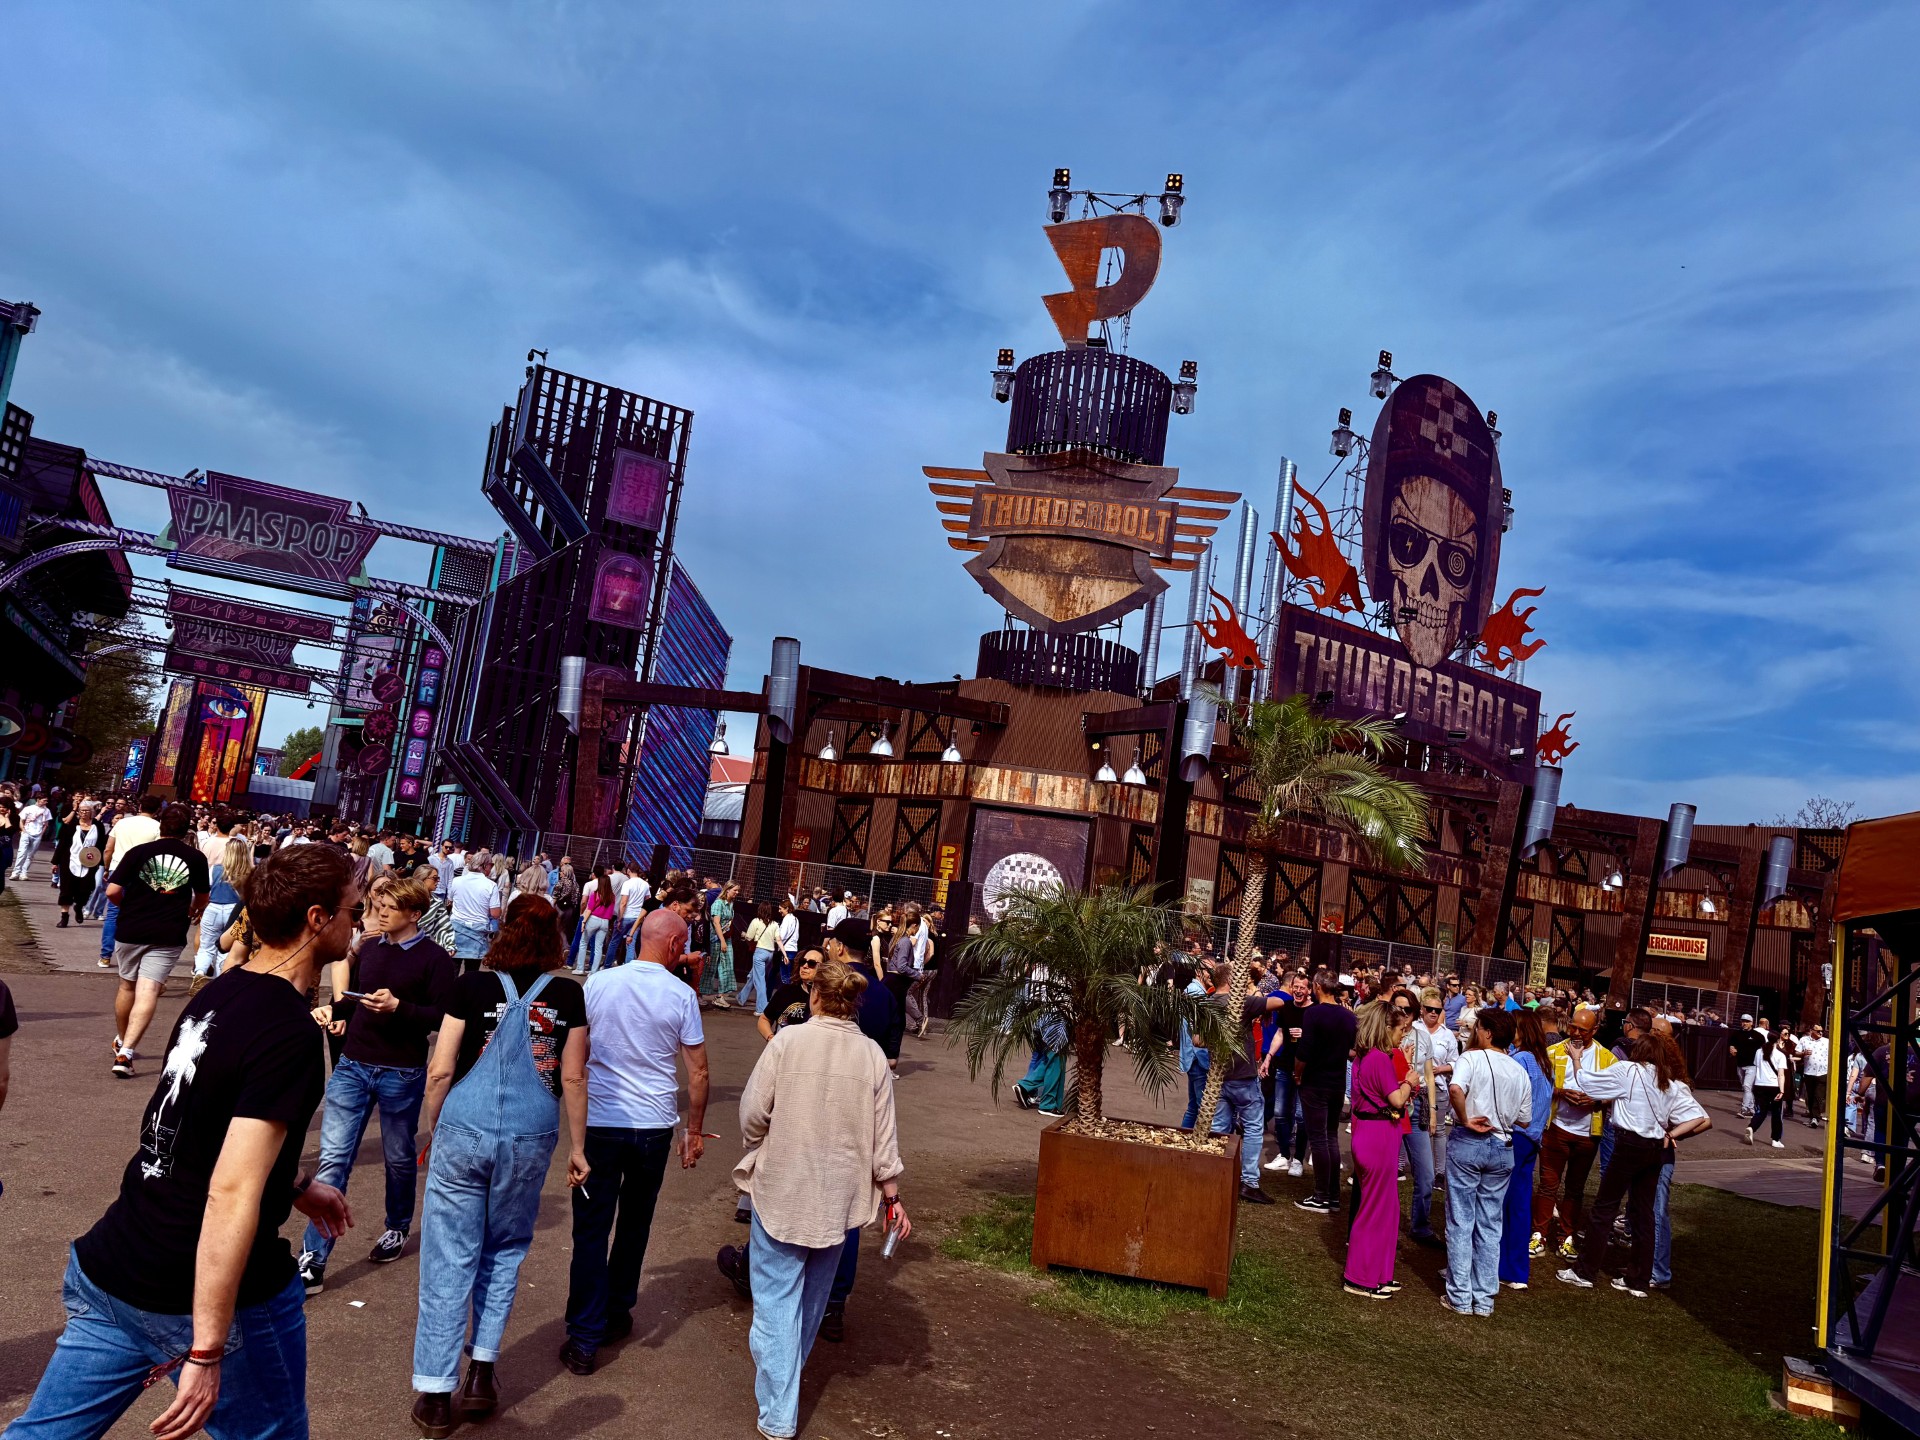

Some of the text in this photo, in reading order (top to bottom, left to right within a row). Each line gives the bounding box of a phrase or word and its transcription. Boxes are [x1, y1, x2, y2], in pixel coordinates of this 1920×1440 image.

[182, 495, 359, 563] PAASPOP
[980, 493, 1173, 545] THUNDERBOLT
[182, 619, 290, 655] PAASPOP
[1294, 630, 1529, 755] THUNDERBOLT
